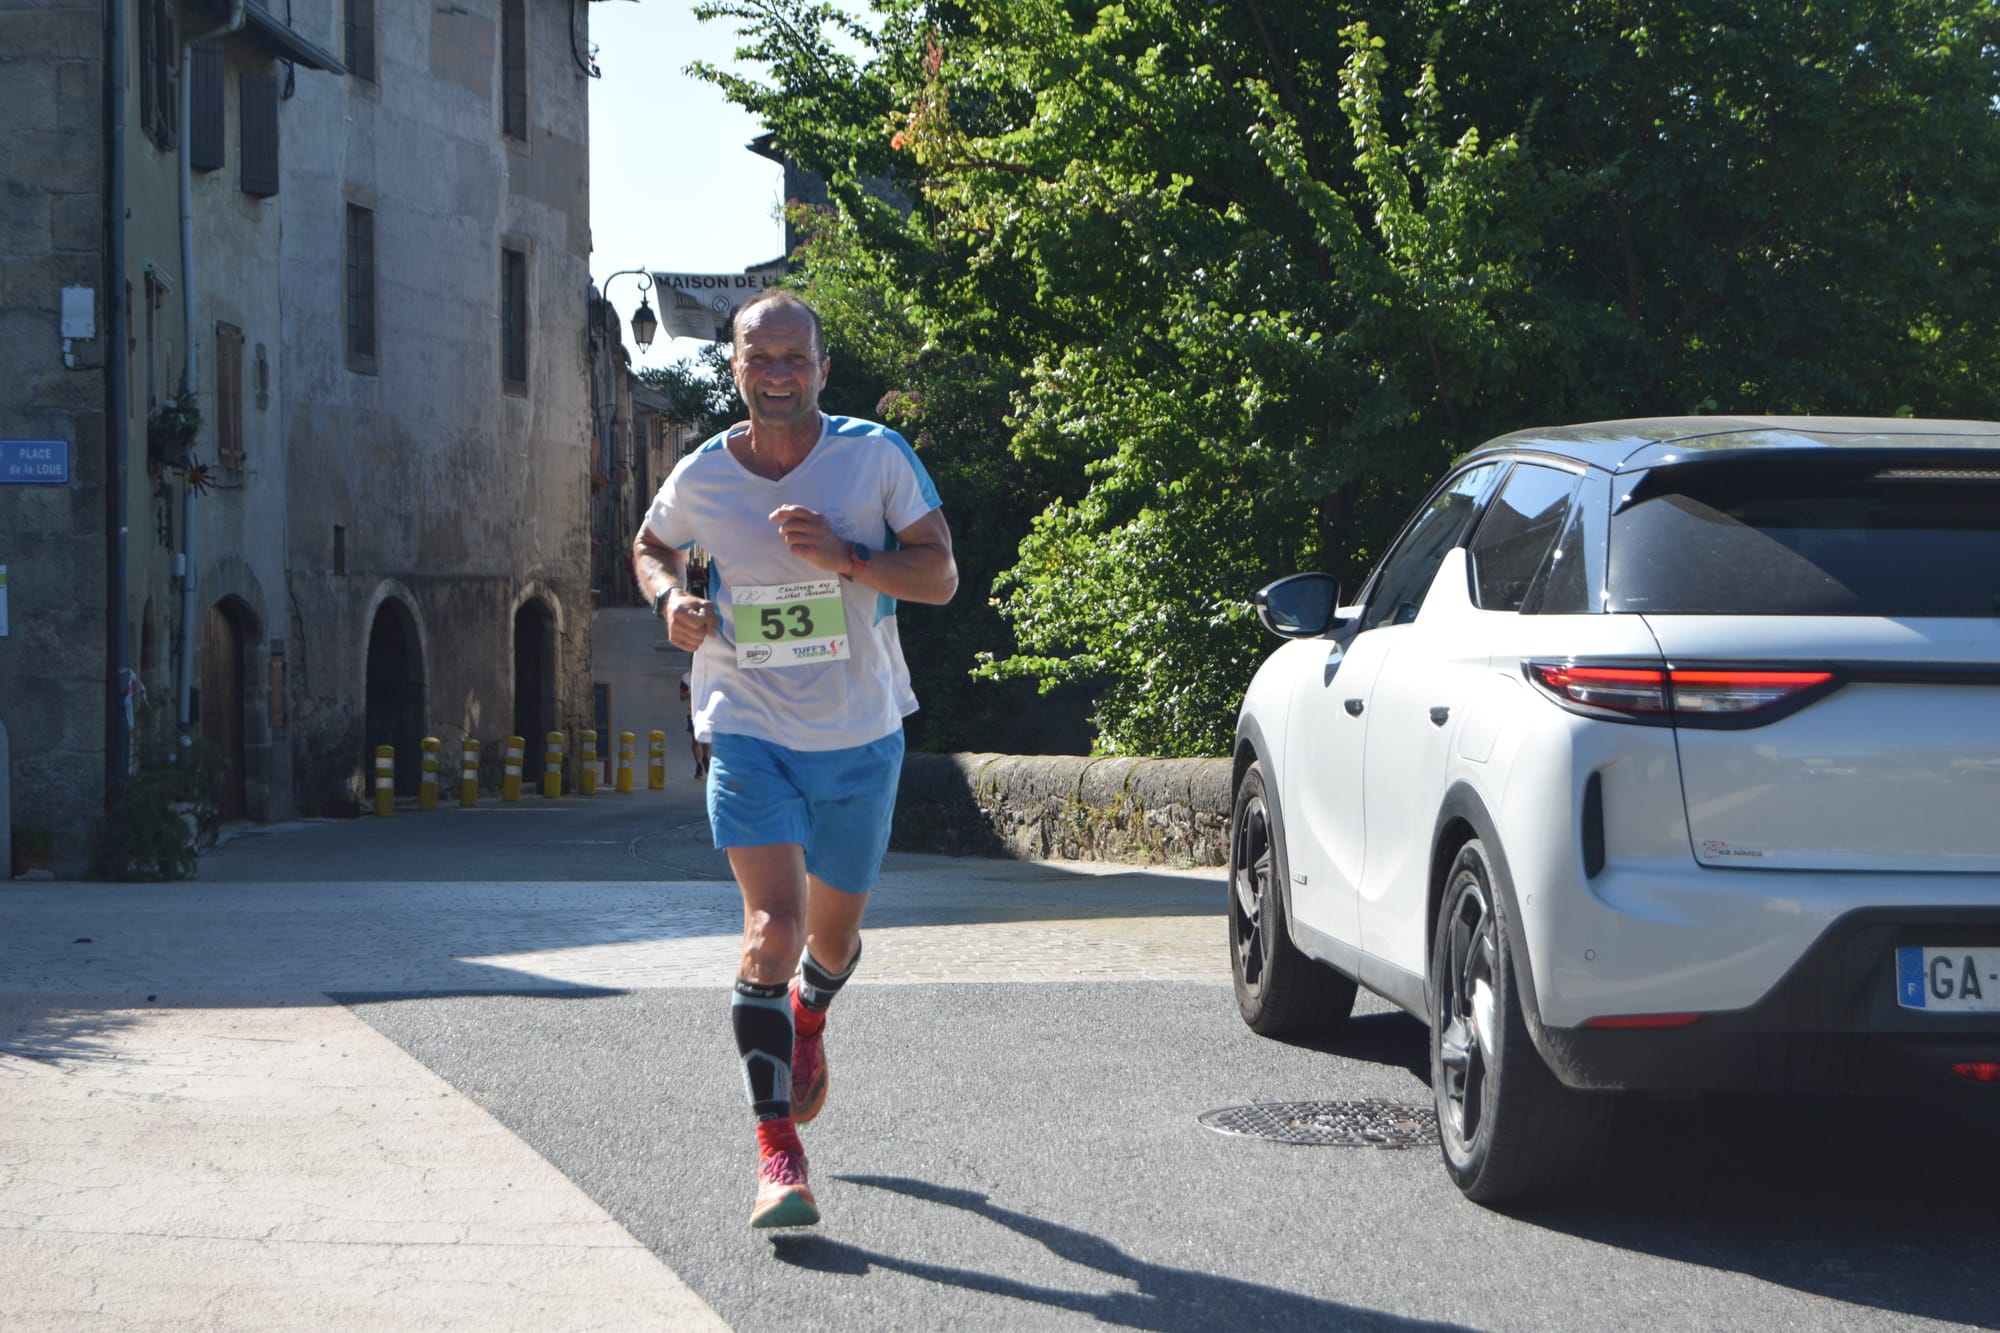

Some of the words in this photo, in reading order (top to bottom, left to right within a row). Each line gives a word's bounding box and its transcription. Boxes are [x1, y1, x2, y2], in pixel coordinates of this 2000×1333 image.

[660, 275, 729, 289] MAISON
[735, 275, 757, 288] DE
[20, 448, 51, 459] PLACE
[9, 464, 21, 475] de
[24, 464, 33, 475] la
[36, 464, 63, 475] LOUE
[760, 604, 814, 640] 53
[1907, 982, 1916, 996] F
